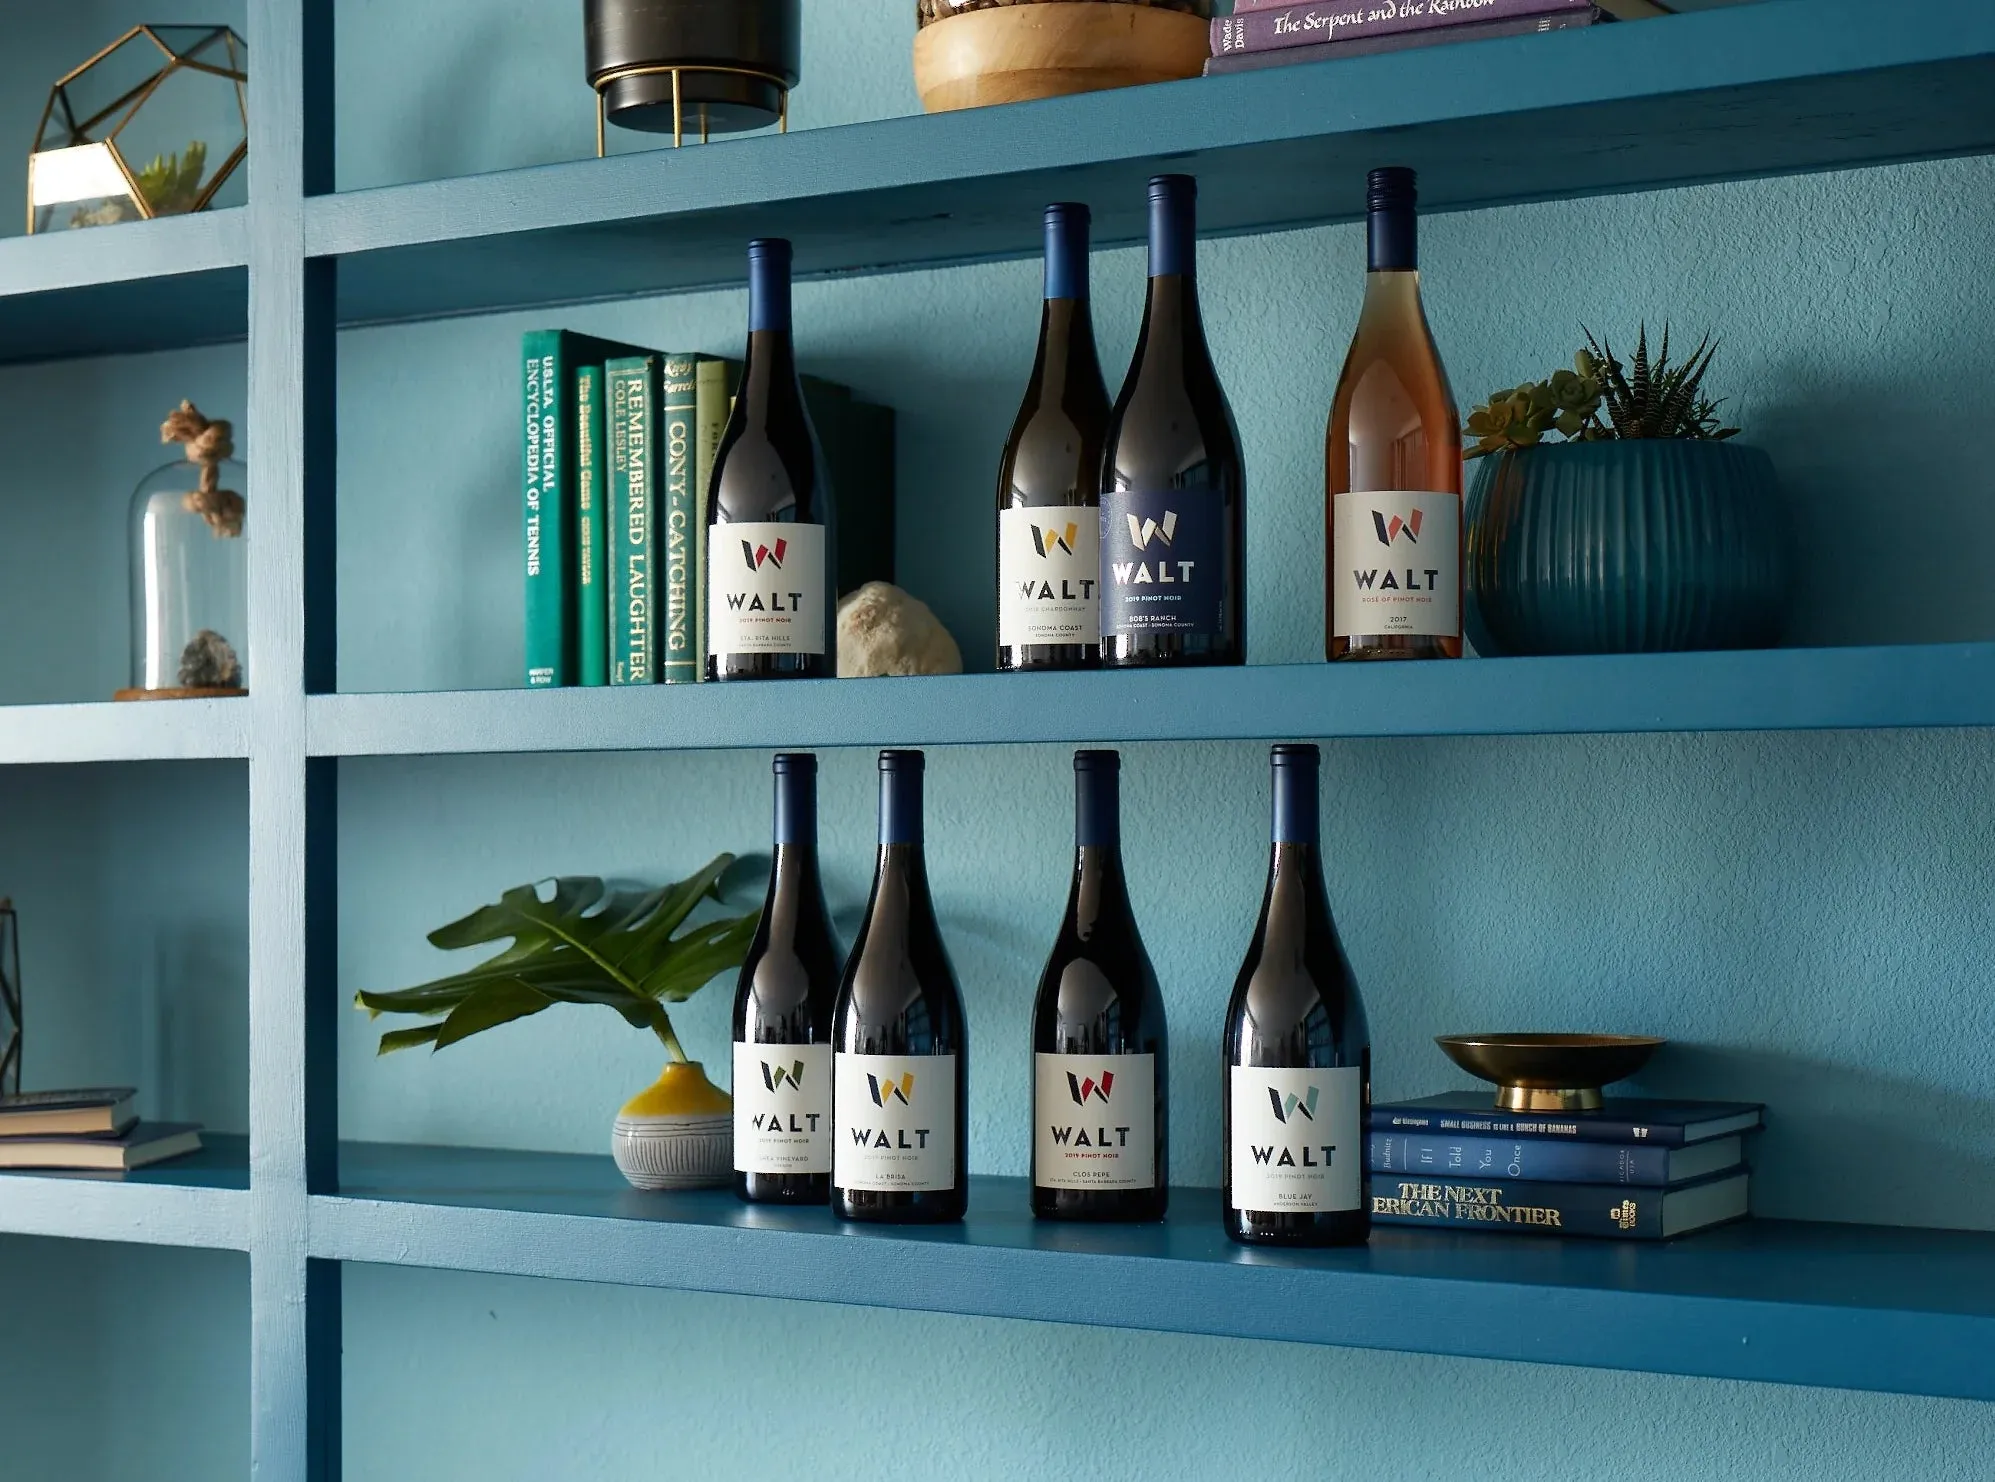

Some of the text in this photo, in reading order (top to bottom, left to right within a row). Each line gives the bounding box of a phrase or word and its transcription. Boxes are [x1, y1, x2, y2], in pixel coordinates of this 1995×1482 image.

[1273, 11, 1300, 35] The
[1304, 8, 1364, 41] Serpent
[1368, 0, 1397, 22] and
[1399, 0, 1423, 17] the
[1223, 19, 1233, 51] Wade
[1235, 18, 1245, 49] Davis
[615, 380, 626, 472] COLE LESLEY
[543, 415, 555, 493] OFFICIAL
[526, 359, 540, 577] ENCYCLOPEDIA OF TENNIS
[627, 379, 646, 681] REMEMBERED LAUGHTER
[668, 421, 687, 651] CONY-CATCHING
[1112, 561, 1195, 584] WALT
[1353, 569, 1438, 590] WALT
[1017, 580, 1095, 600] WALT
[726, 592, 802, 612] WALT
[1129, 615, 1149, 623] BOB'S
[752, 1113, 820, 1132] WALT
[1440, 1119, 1461, 1129] SMALL
[1461, 1120, 1491, 1131] BUSINESS
[1516, 1122, 1538, 1132] BUNCH
[1538, 1123, 1547, 1133] OF
[1547, 1123, 1577, 1135] BANANAS
[851, 1127, 930, 1149] WALT
[1051, 1125, 1130, 1147] WALT
[1251, 1145, 1336, 1166] WALT
[1420, 1154, 1433, 1163] If
[1449, 1145, 1462, 1168] Told
[1479, 1149, 1492, 1170] You
[1507, 1144, 1522, 1178] Once
[1398, 1182, 1502, 1205] THE NEXT
[1372, 1196, 1562, 1227] ERICAN FRONTIER
